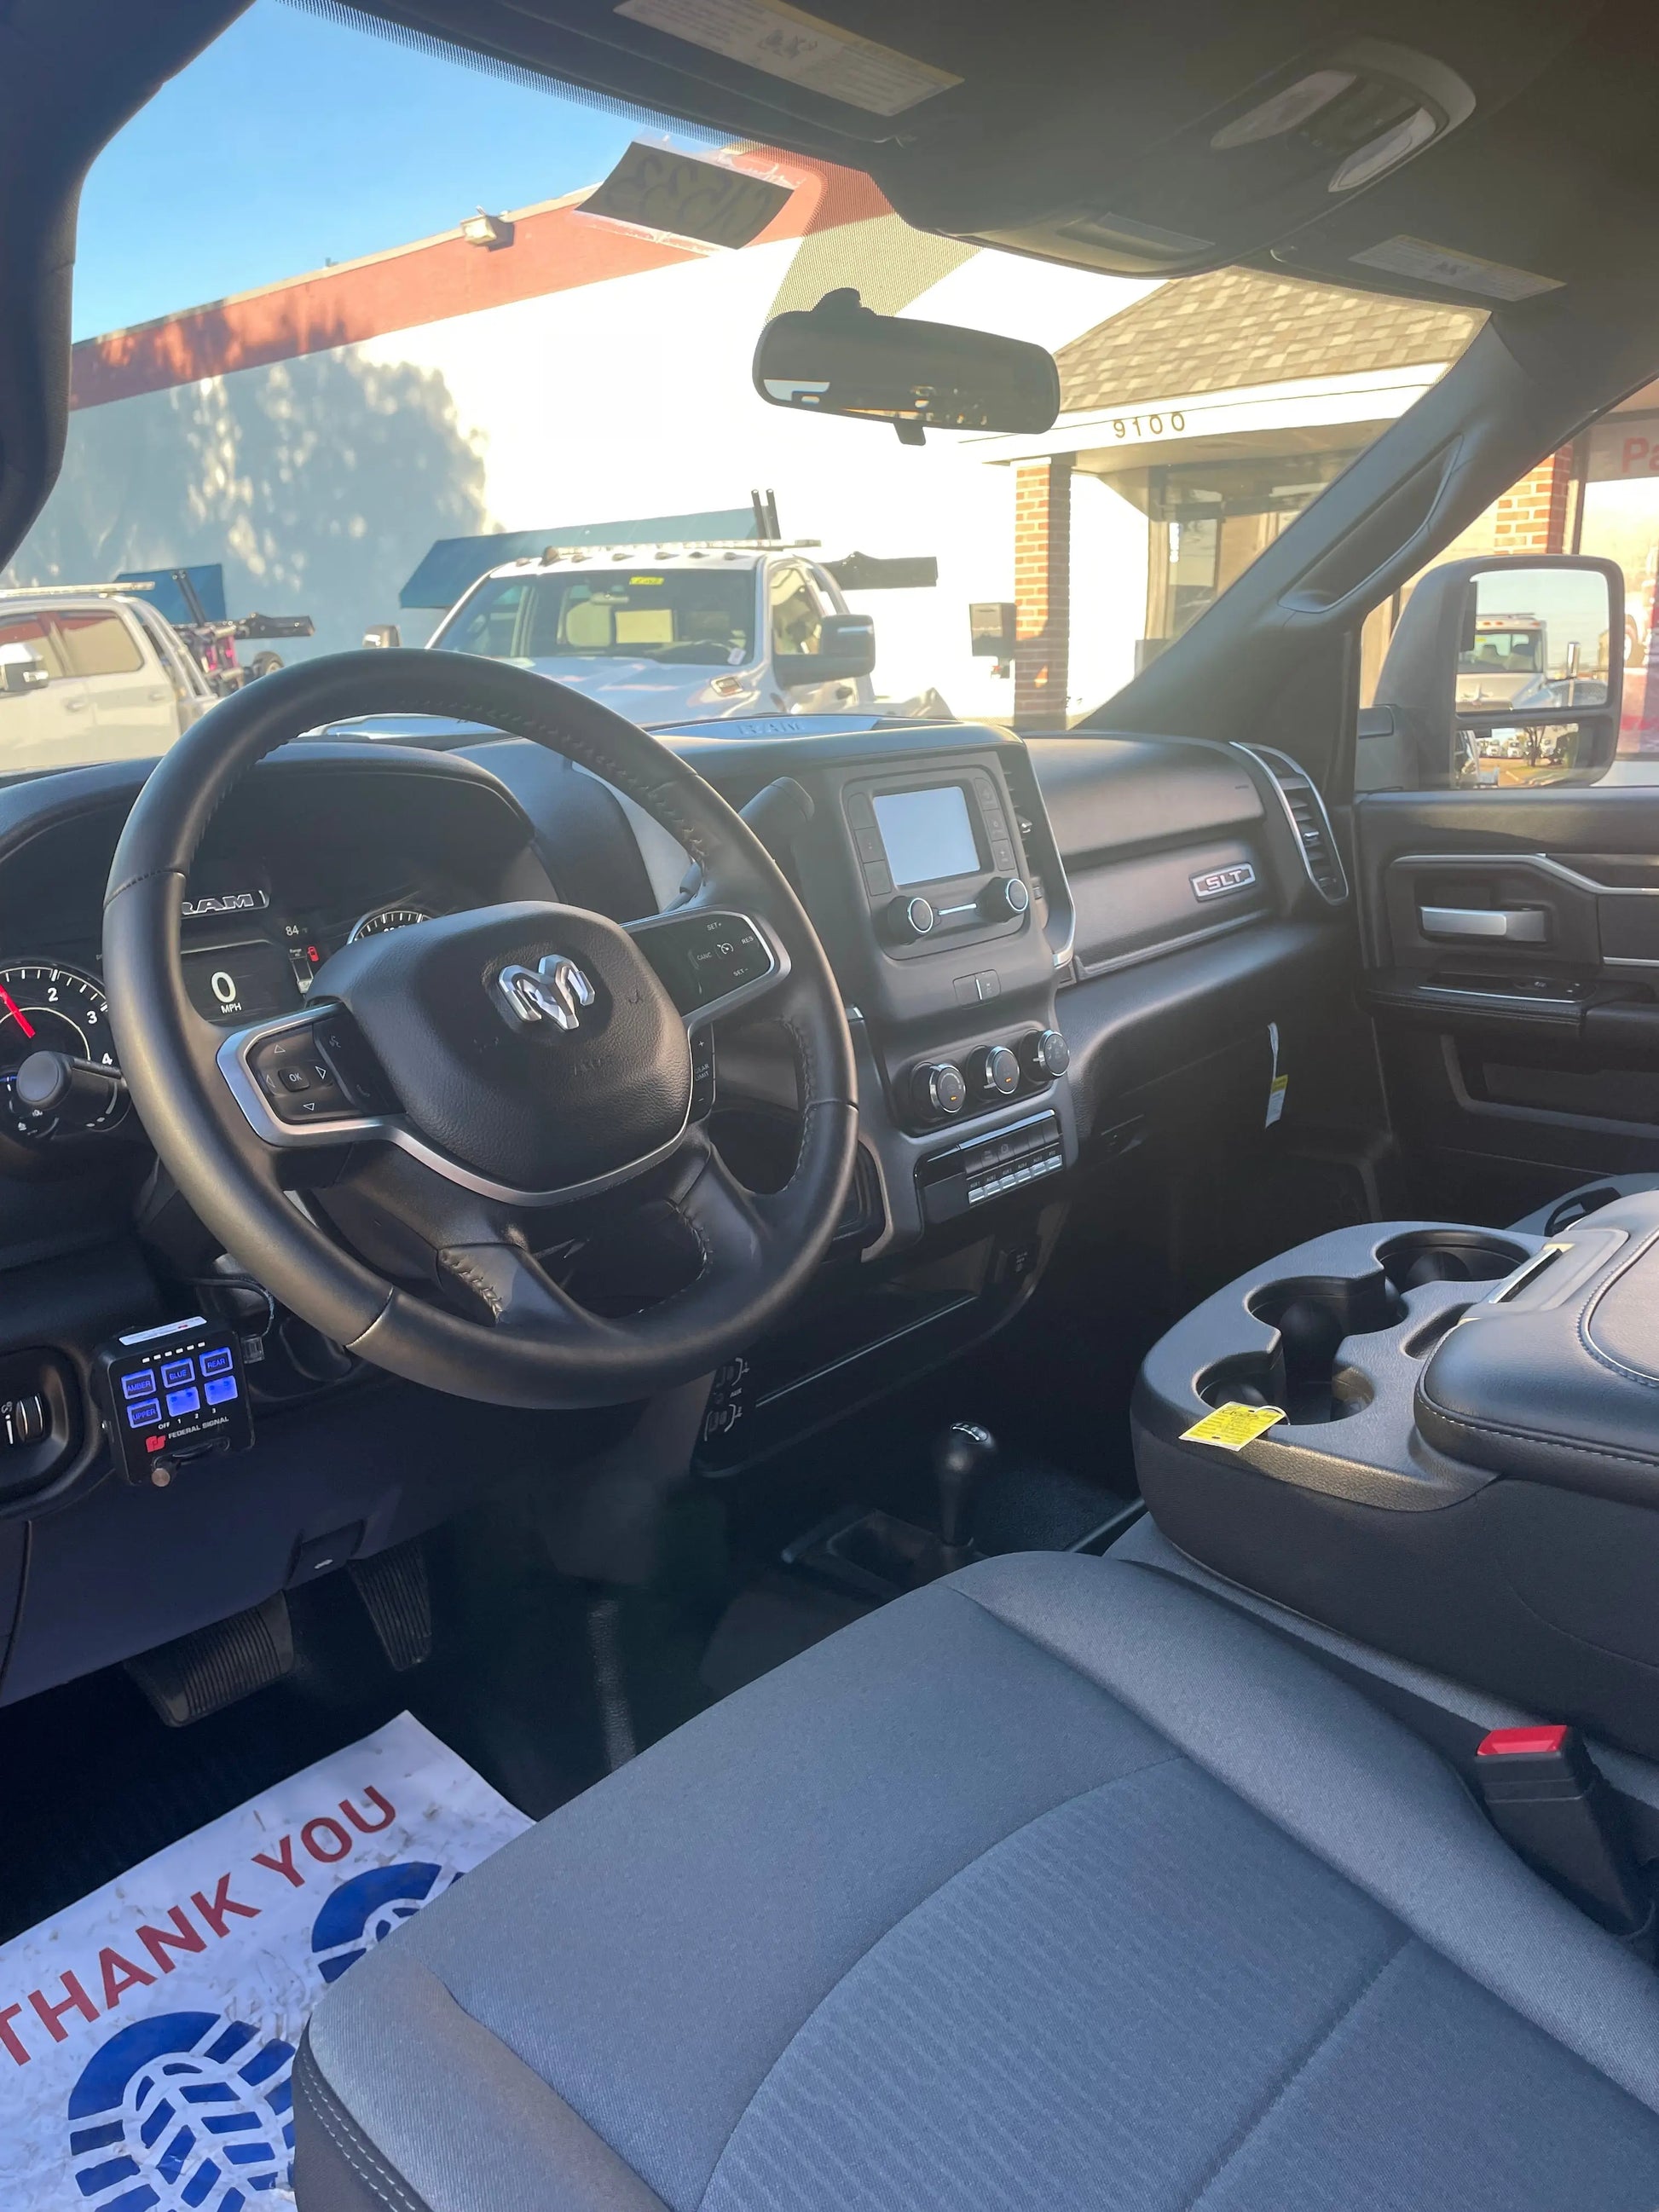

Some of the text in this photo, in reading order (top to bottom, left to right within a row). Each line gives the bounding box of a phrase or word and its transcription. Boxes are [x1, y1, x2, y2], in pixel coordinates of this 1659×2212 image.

[1113, 412, 1185, 438] 9100
[1205, 869, 1242, 891] SLT
[285, 924, 299, 936] 84
[47, 987, 59, 1002] 2
[211, 971, 237, 1003] 0
[220, 1002, 242, 1014] MPH
[86, 1010, 98, 1025] 3
[101, 1052, 113, 1066] 4
[288, 1072, 303, 1083] OK
[127, 1357, 226, 1392] AMBER BLUE REAR
[132, 1407, 157, 1421] UPPER
[158, 1421, 171, 1430] OFF
[168, 1416, 229, 1439] FEDERAL SIGNAL
[0, 1786, 396, 2067] THANK YOU
